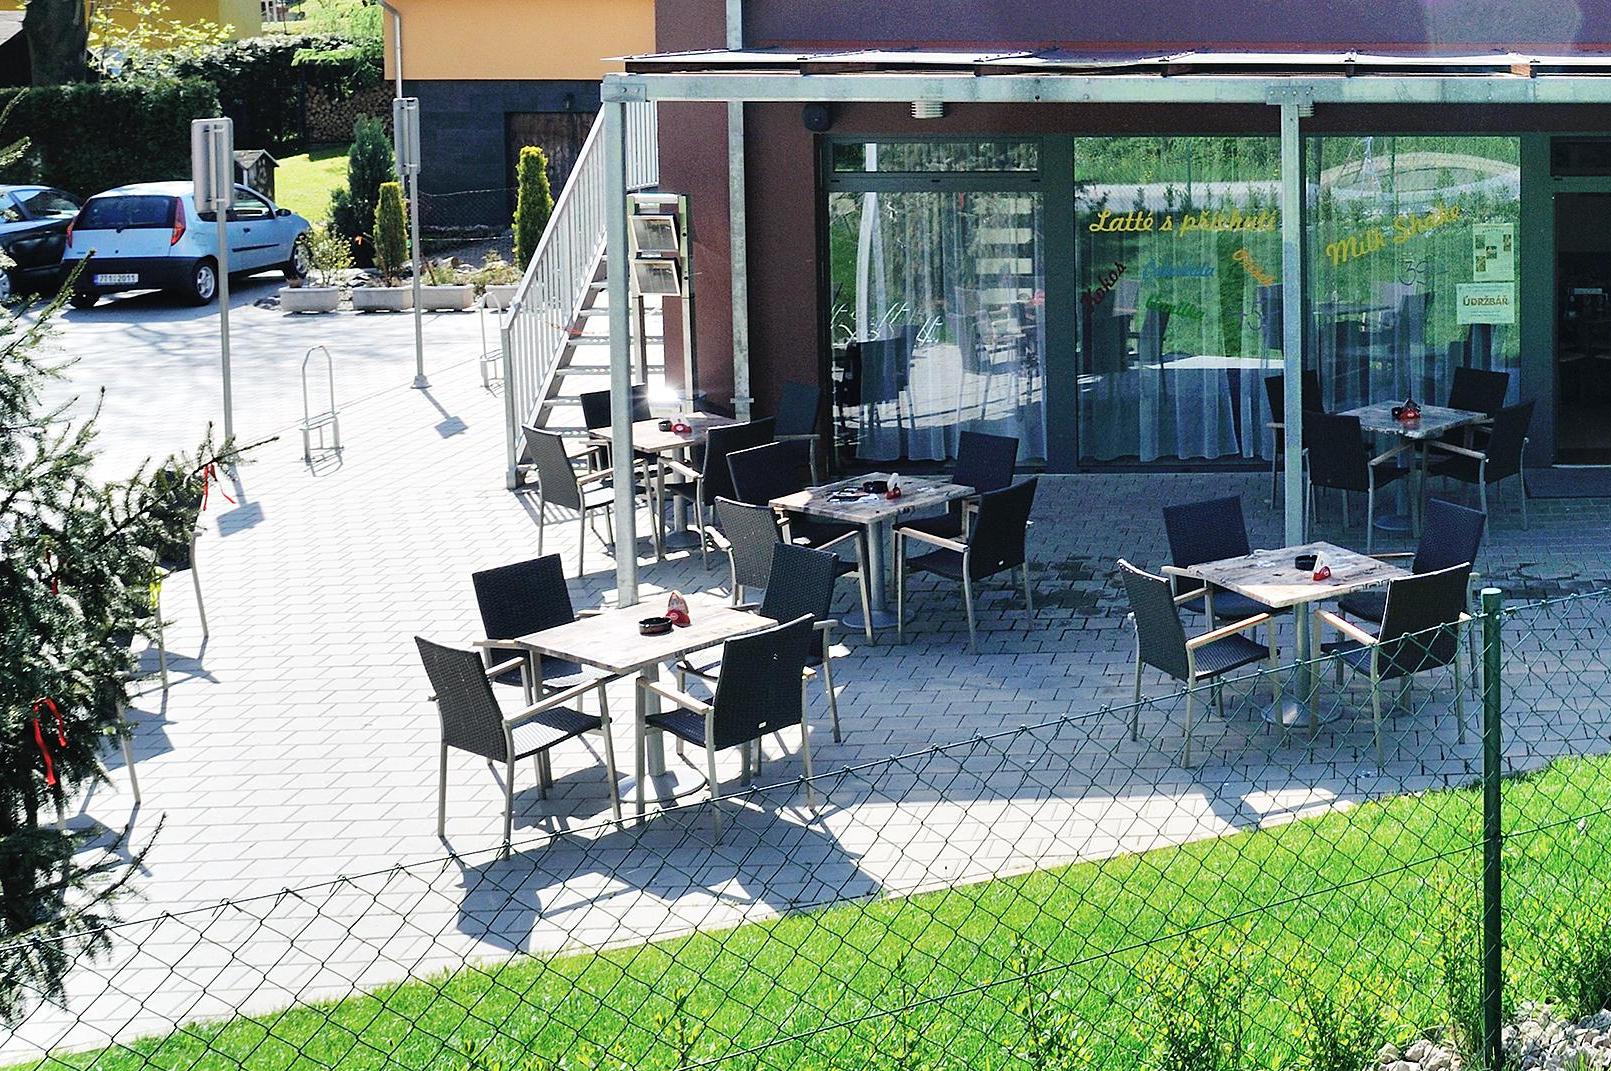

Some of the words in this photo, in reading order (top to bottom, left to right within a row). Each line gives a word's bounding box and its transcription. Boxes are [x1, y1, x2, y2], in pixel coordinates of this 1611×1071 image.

[1326, 228, 1386, 266] Milk
[1393, 201, 1461, 245] Shake
[1081, 262, 1127, 305] Kokos
[1463, 295, 1509, 306] ÚDRŽBÁŘ
